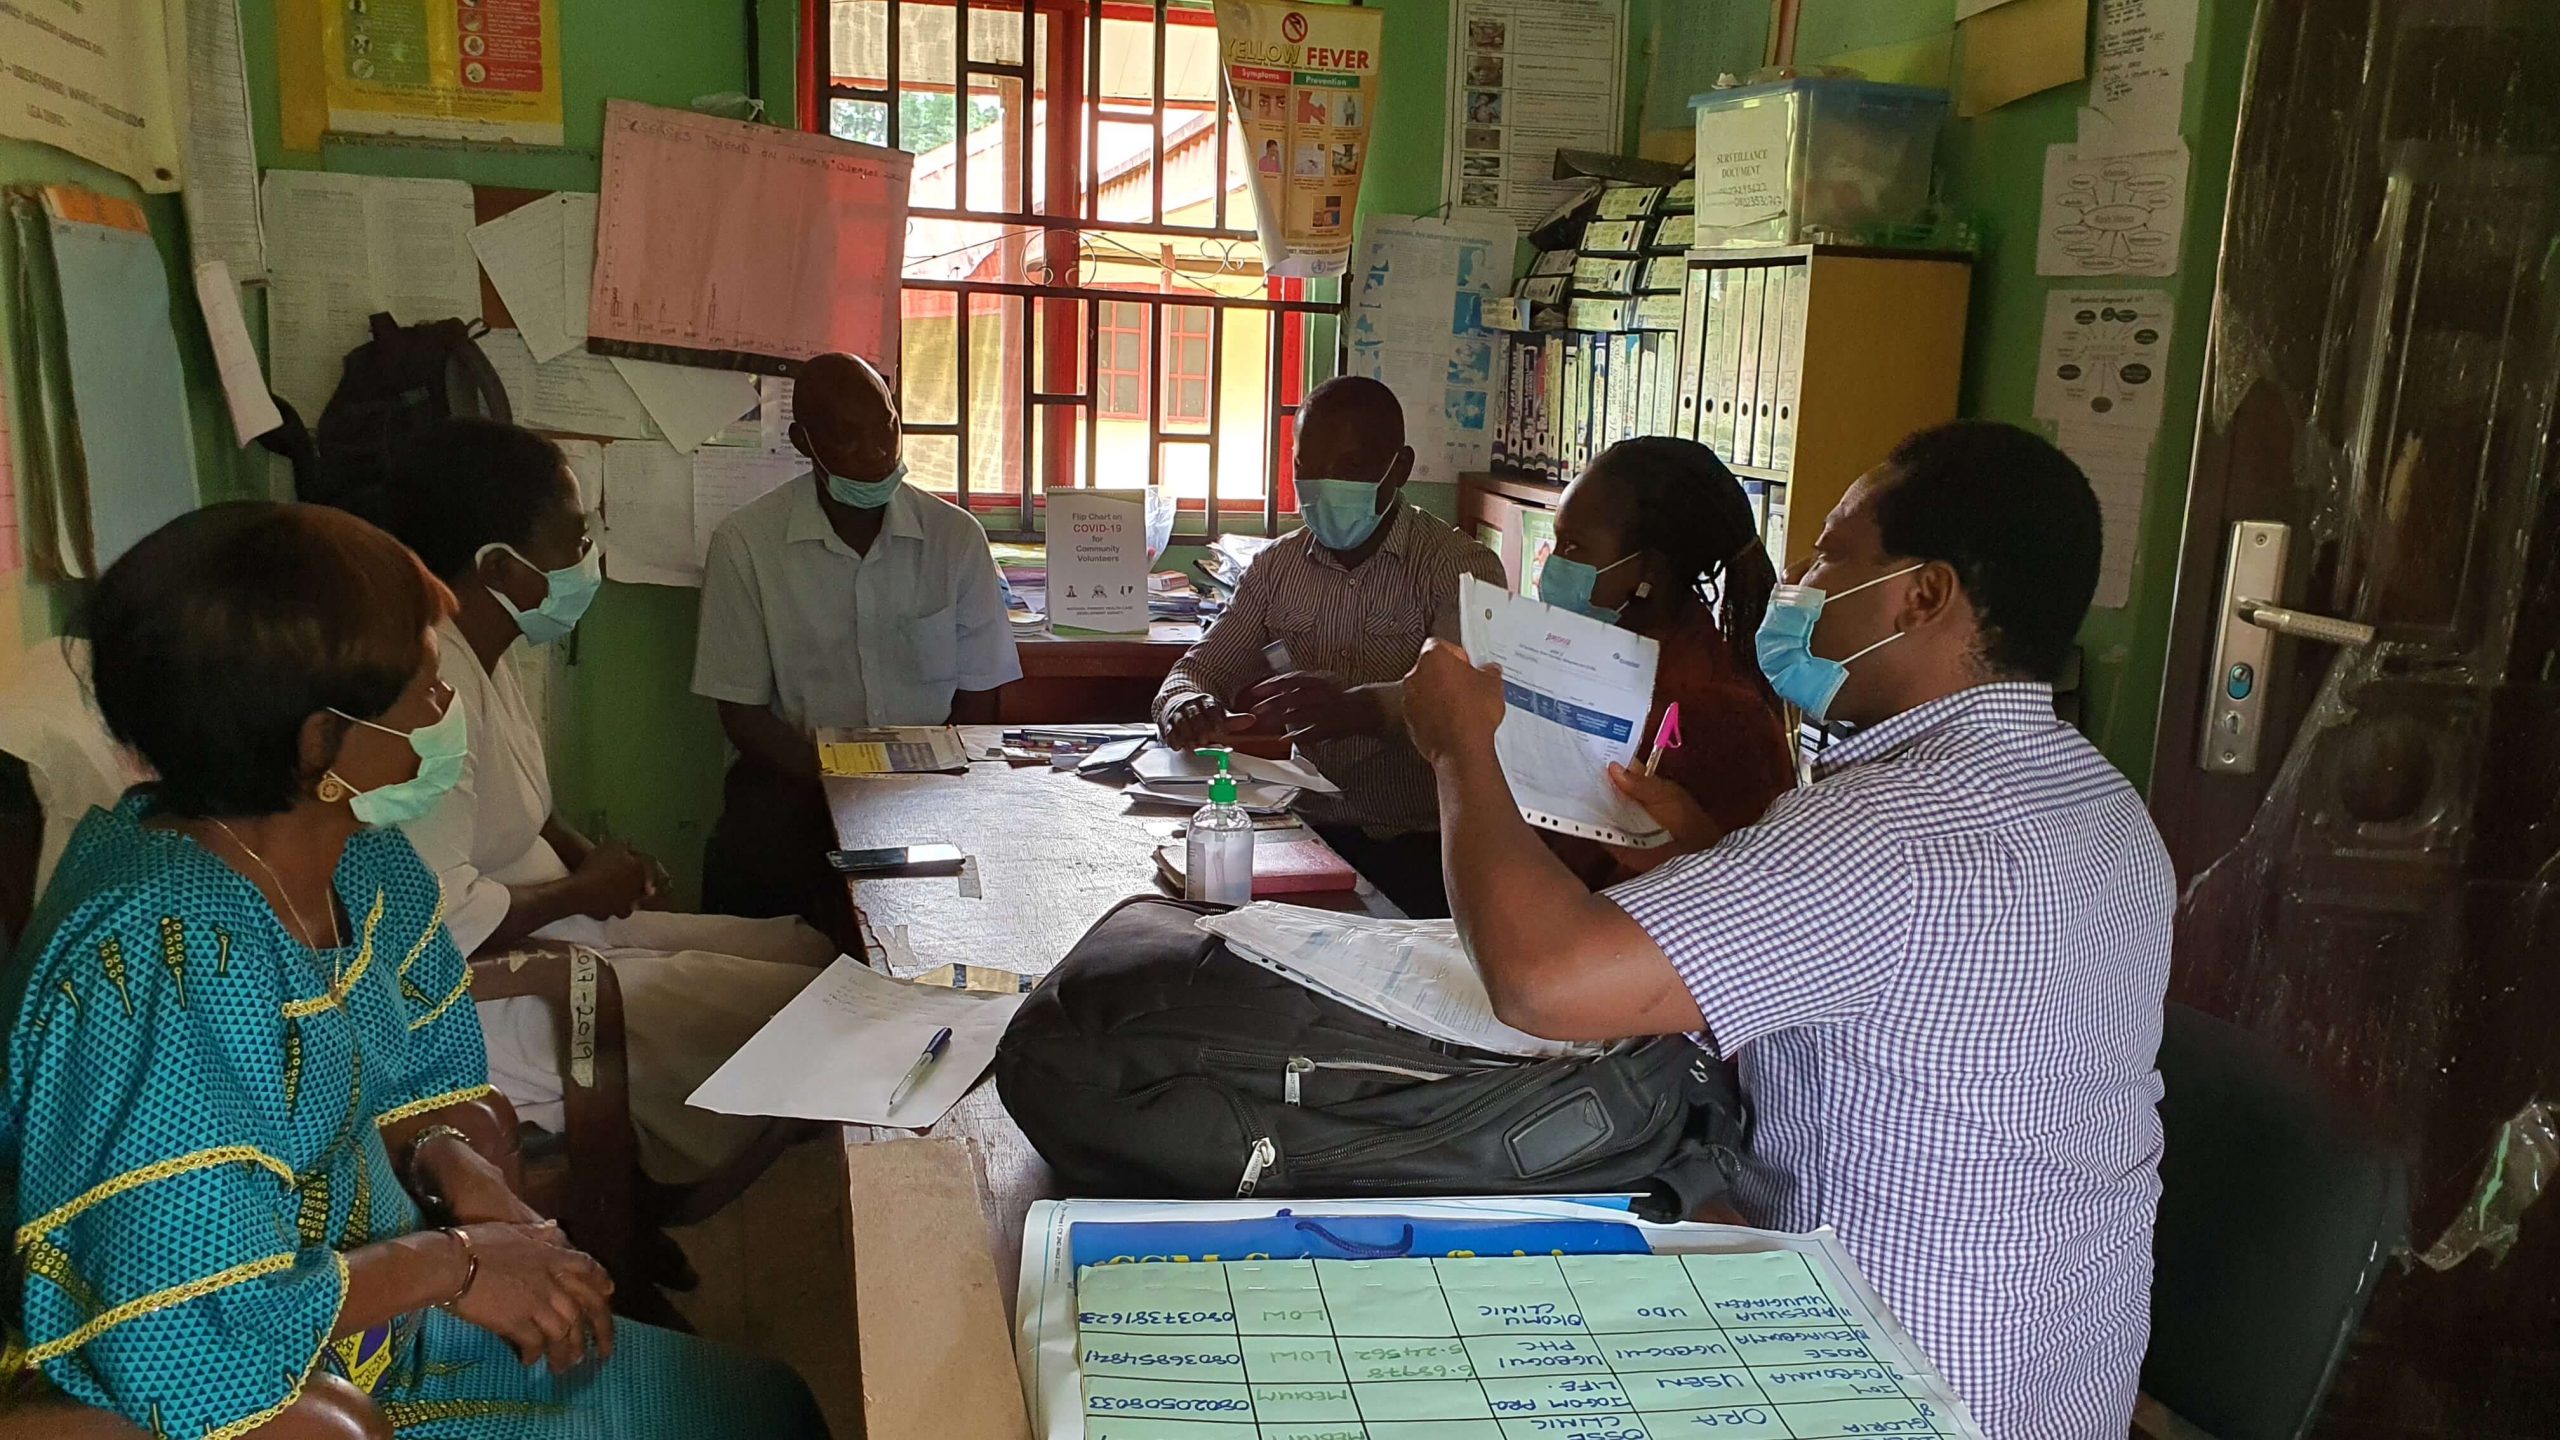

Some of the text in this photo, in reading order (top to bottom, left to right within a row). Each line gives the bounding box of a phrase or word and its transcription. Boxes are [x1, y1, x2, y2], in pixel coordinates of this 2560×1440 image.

[1228, 39, 1369, 69] YELLOW FEVER
[1242, 68, 1280, 80] Symptoms
[1306, 75, 1347, 87] Prevention
[1716, 149, 1768, 164] SURVEILLANCE
[1721, 165, 1760, 179] DOCUMENT
[1072, 512, 1086, 522] Flip
[1088, 512, 1111, 521] Chart
[1073, 524, 1122, 533] COVID-19
[1092, 535, 1103, 543] for
[1076, 545, 1120, 554] Community
[1077, 554, 1120, 563] Volunteers
[1263, 1310, 1324, 1321] LOW
[1478, 1303, 1556, 1317] CLINIC
[1637, 1307, 1688, 1318] UDO
[1736, 1307, 1838, 1321] ADESUWA
[1505, 1314, 1582, 1326] OKOMU
[1355, 1343, 1464, 1361] 5.24562
[1517, 1340, 1576, 1352] PHC
[1616, 1343, 1727, 1360] UGBOGUI
[1271, 1350, 1332, 1363] LOW
[1804, 1347, 1868, 1359] ROSE
[1499, 1355, 1603, 1368] UGBOGUI
[1657, 1373, 1745, 1389] USEN
[1770, 1368, 1883, 1385] OGBONNA
[1257, 1389, 1347, 1401] MEDIUM
[1851, 1383, 1898, 1395] JOY
[1090, 1396, 1250, 1411] 08020508033
[1919, 1403, 1935, 1418] 8
[1531, 1416, 1620, 1430] CLINIC
[1690, 1408, 1767, 1427] ORA
[1842, 1418, 1929, 1433] GLORIA
